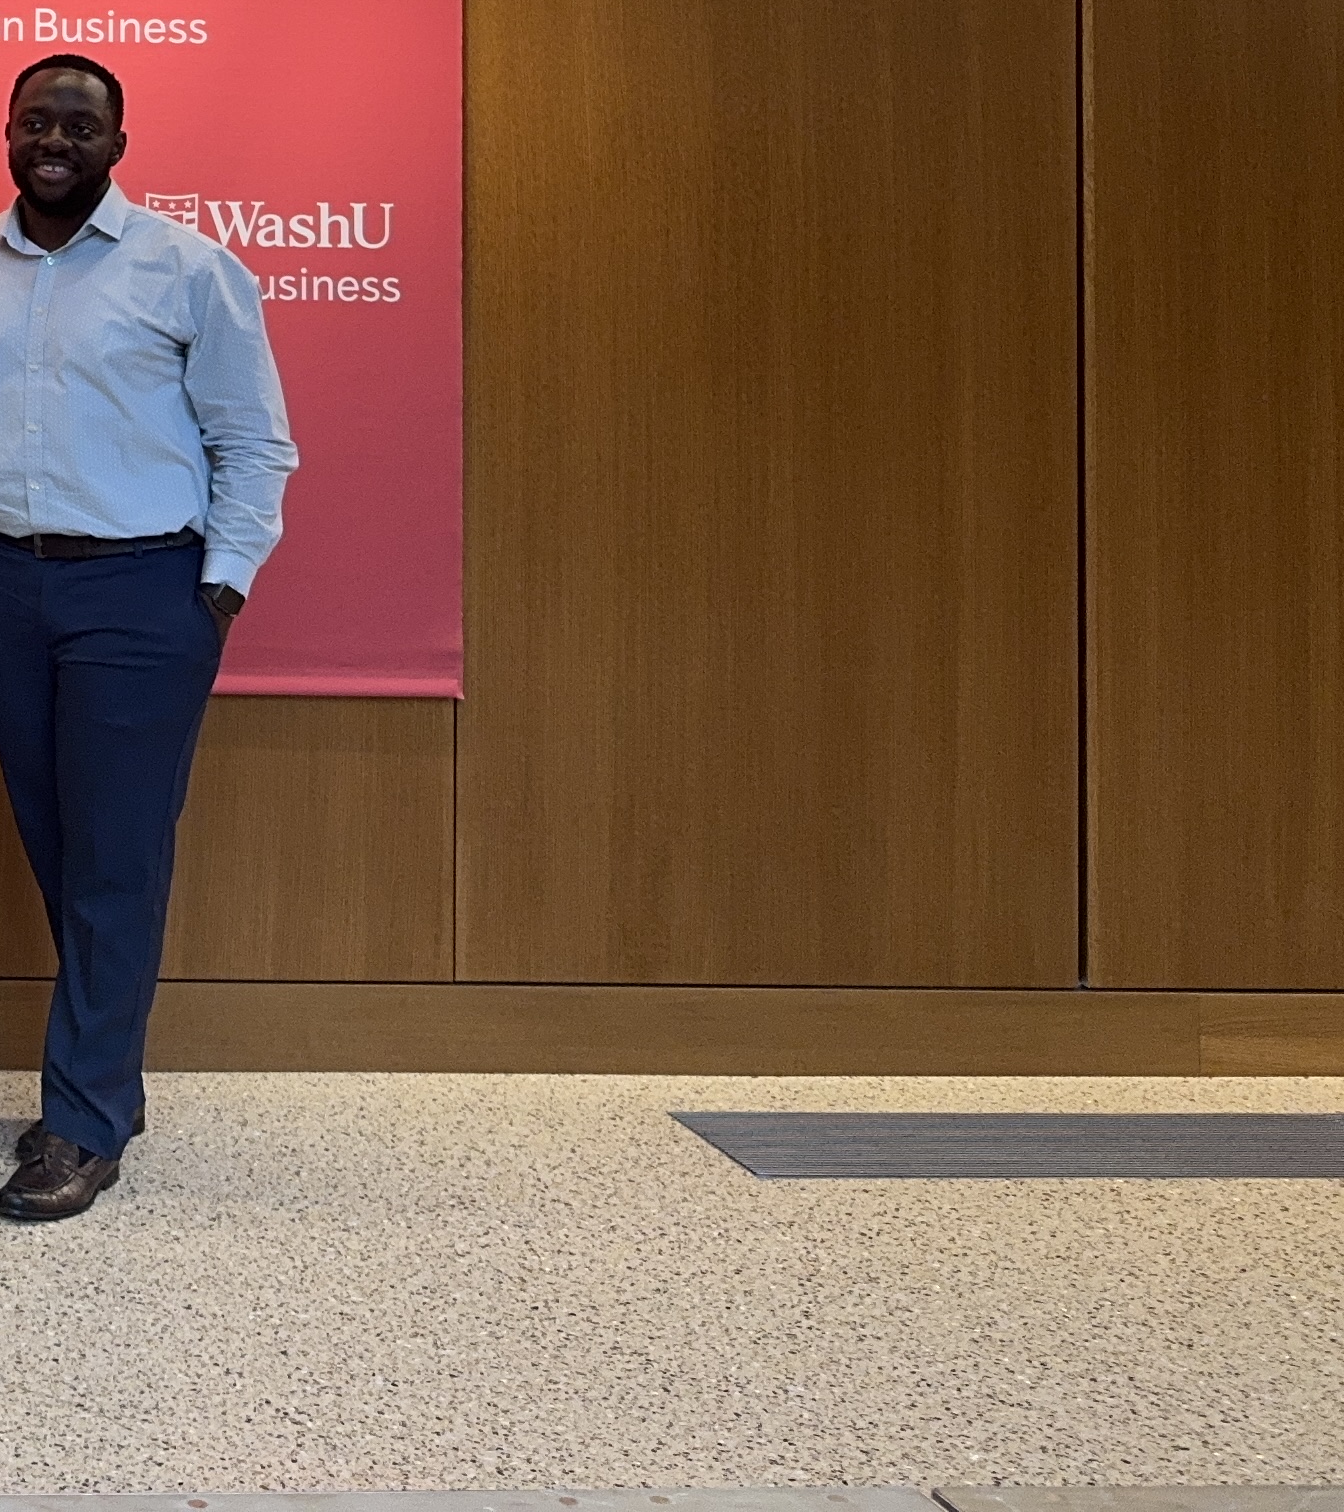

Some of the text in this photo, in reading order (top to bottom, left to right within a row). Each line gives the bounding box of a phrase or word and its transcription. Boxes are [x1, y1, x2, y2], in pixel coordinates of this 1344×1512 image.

[34, 7, 208, 45] Business
[204, 200, 394, 250] WashU
[255, 267, 401, 303] usiness
